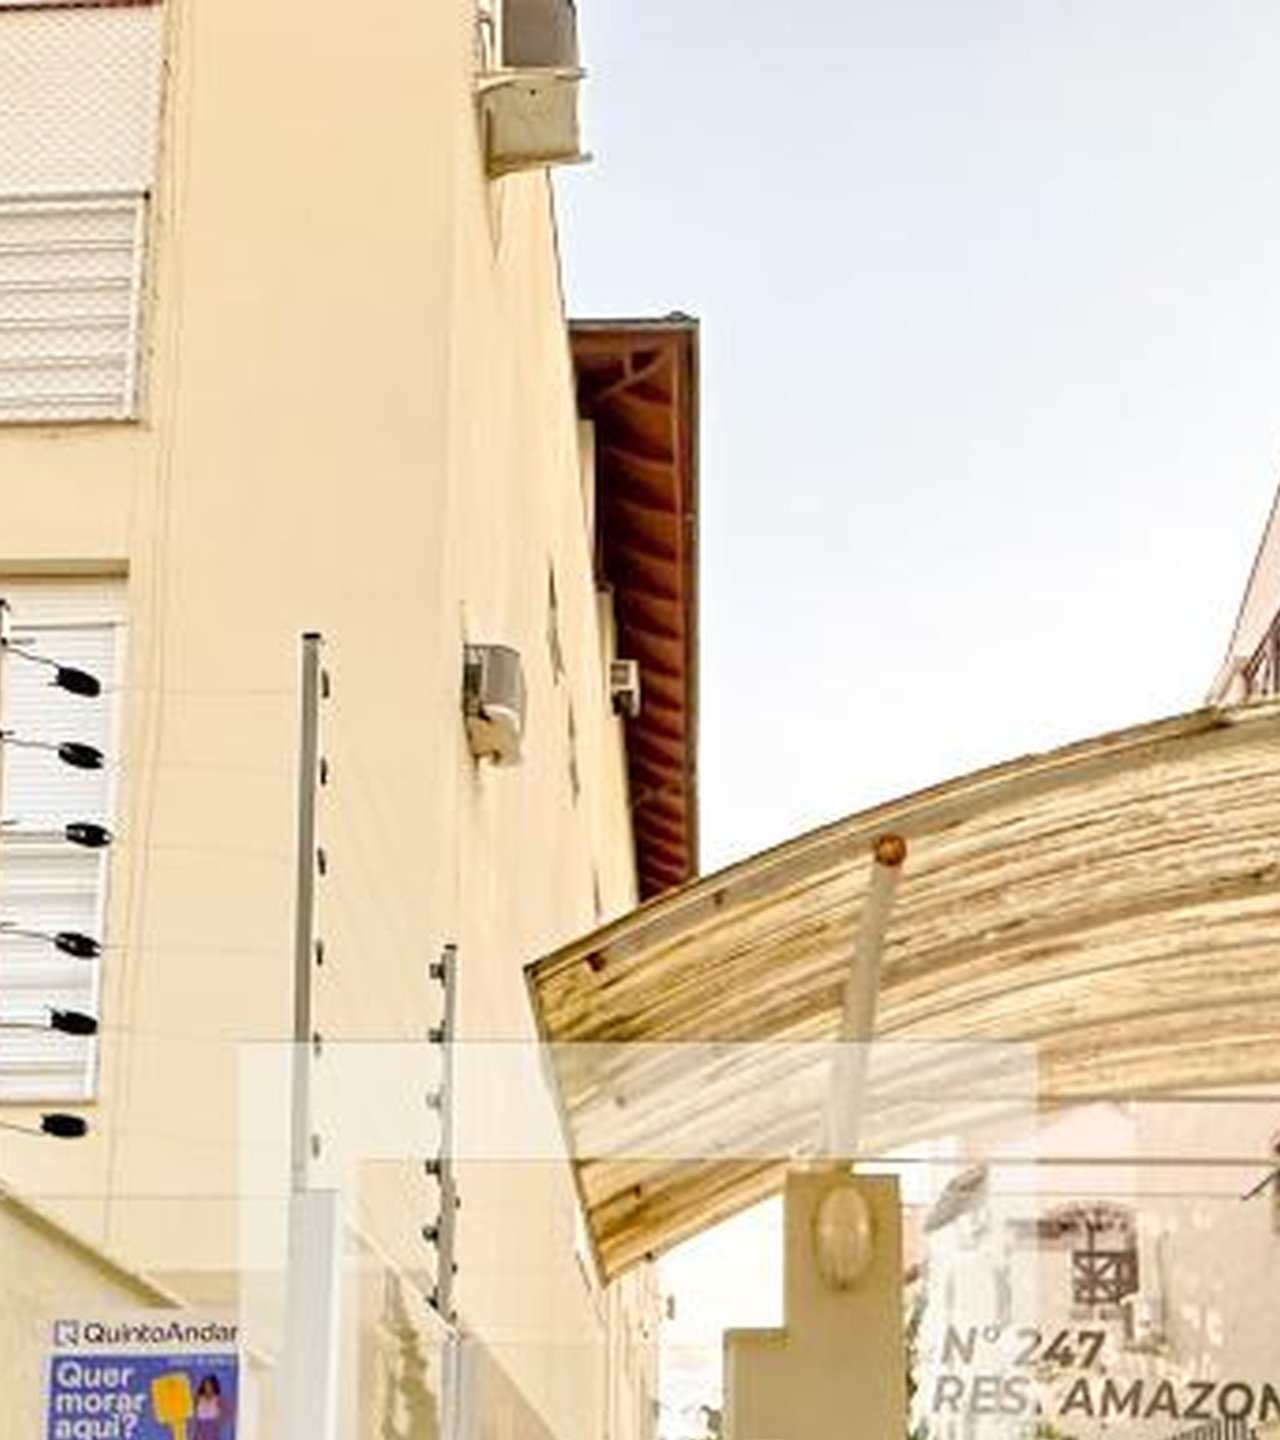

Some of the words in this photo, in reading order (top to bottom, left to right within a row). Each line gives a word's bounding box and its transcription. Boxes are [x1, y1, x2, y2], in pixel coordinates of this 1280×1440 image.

[83, 1322, 238, 1345] QuintoAndar
[1014, 1328, 1107, 1369] 247
[56, 1361, 135, 1387] Quer
[55, 1392, 146, 1414] morar
[931, 1375, 1043, 1415] RES.
